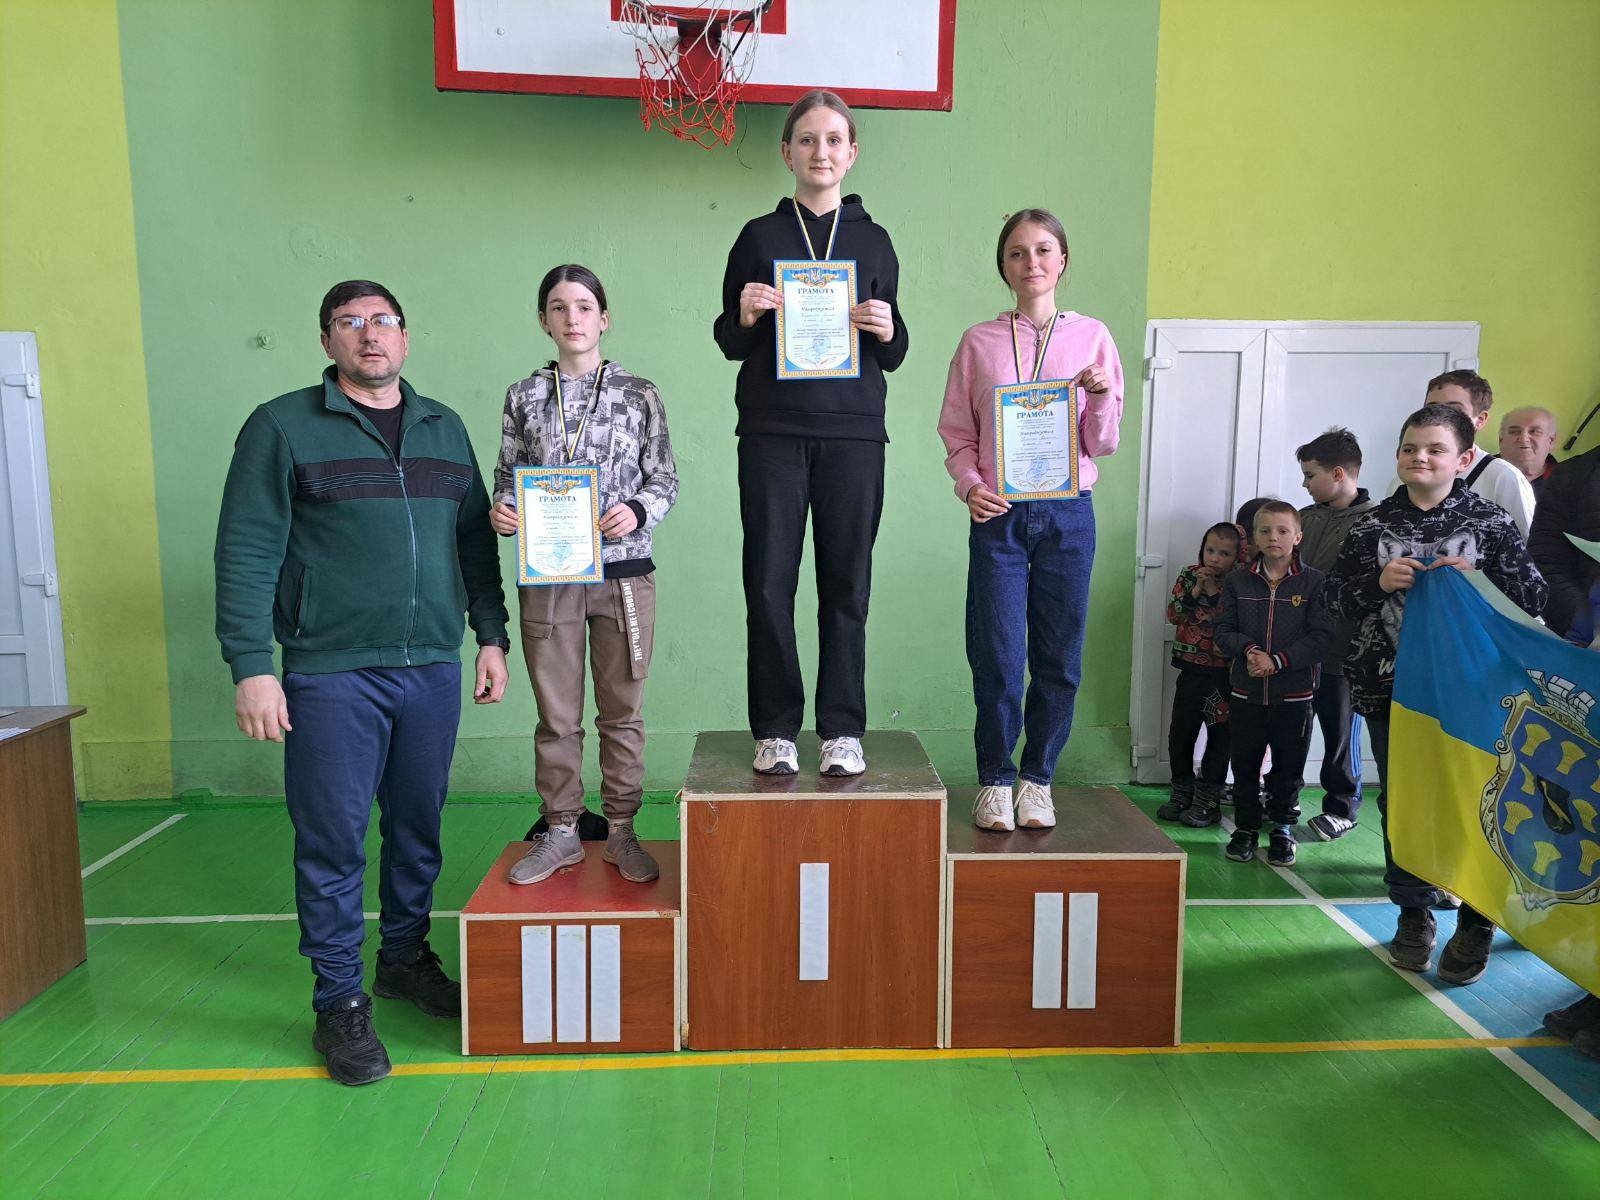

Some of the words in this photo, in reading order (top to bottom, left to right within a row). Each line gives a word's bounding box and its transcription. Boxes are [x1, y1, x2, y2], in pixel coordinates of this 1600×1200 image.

[1017, 410, 1054, 419] ГРАМОТА
[538, 495, 577, 503] ГРАМОТА
[629, 616, 638, 627] ME
[631, 627, 640, 644] TOLD
[633, 645, 642, 661] THEY
